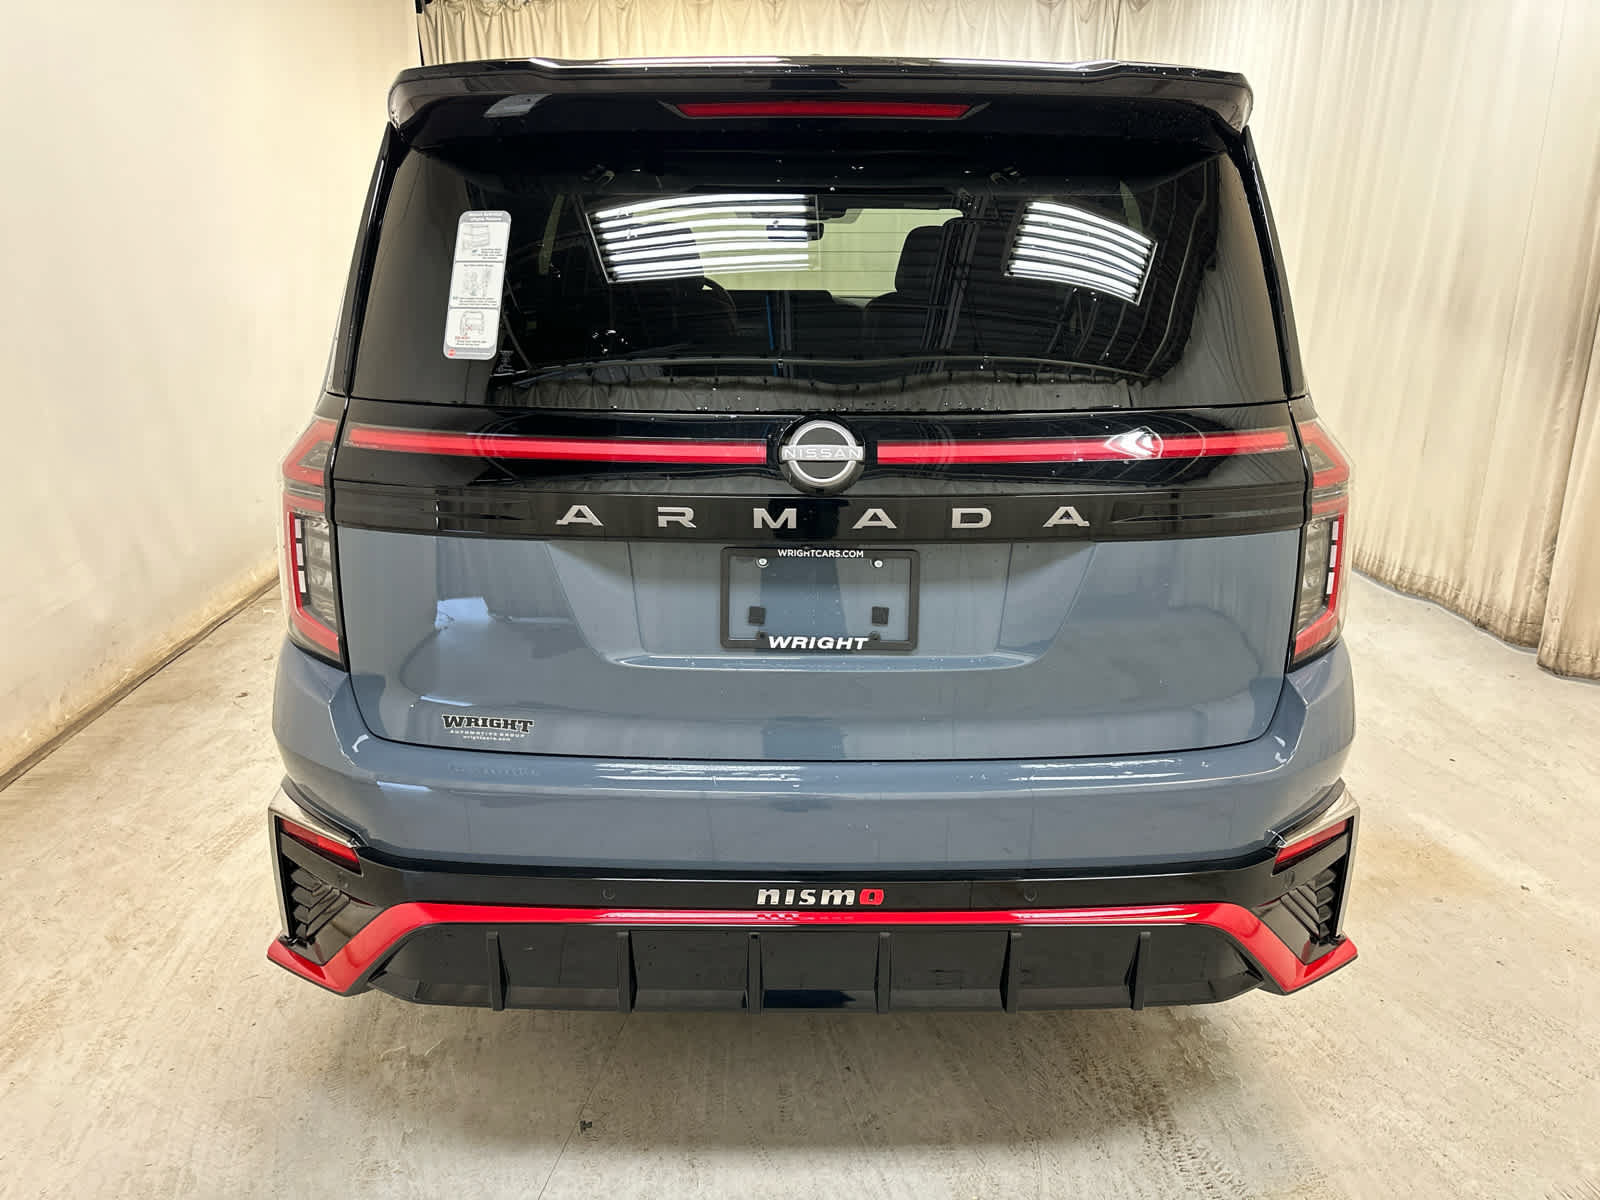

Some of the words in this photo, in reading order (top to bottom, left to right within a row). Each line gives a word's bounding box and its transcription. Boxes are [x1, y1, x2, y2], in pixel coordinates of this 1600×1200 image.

[784, 447, 861, 459] NISSAN
[555, 504, 1090, 529] ARMADA
[777, 549, 864, 558] WRIGHTCARS.COM
[768, 636, 869, 650] WRIGHT
[441, 714, 534, 733] WRIGHT
[757, 888, 885, 905] nismo
